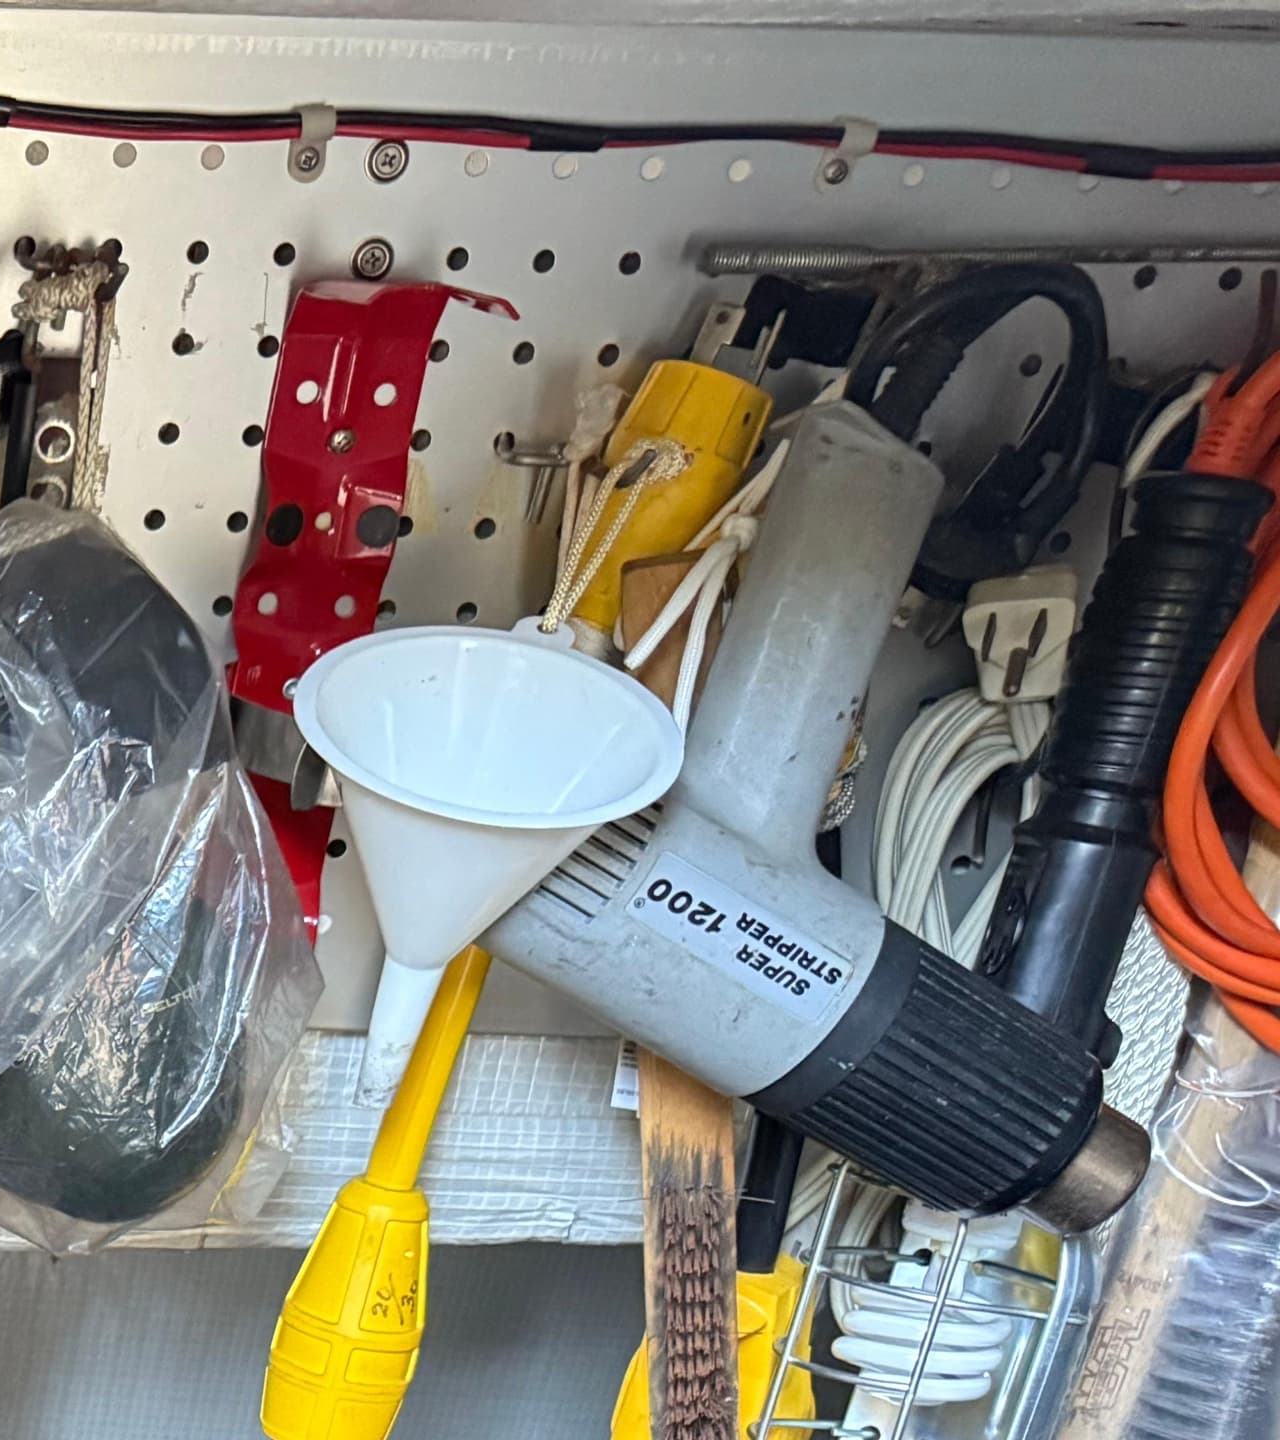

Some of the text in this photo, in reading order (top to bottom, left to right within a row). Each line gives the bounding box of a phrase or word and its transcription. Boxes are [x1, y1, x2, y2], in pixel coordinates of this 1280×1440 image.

[646, 878, 727, 933] 1200
[735, 944, 811, 996] SUPER
[736, 912, 843, 985] STRIPPER
